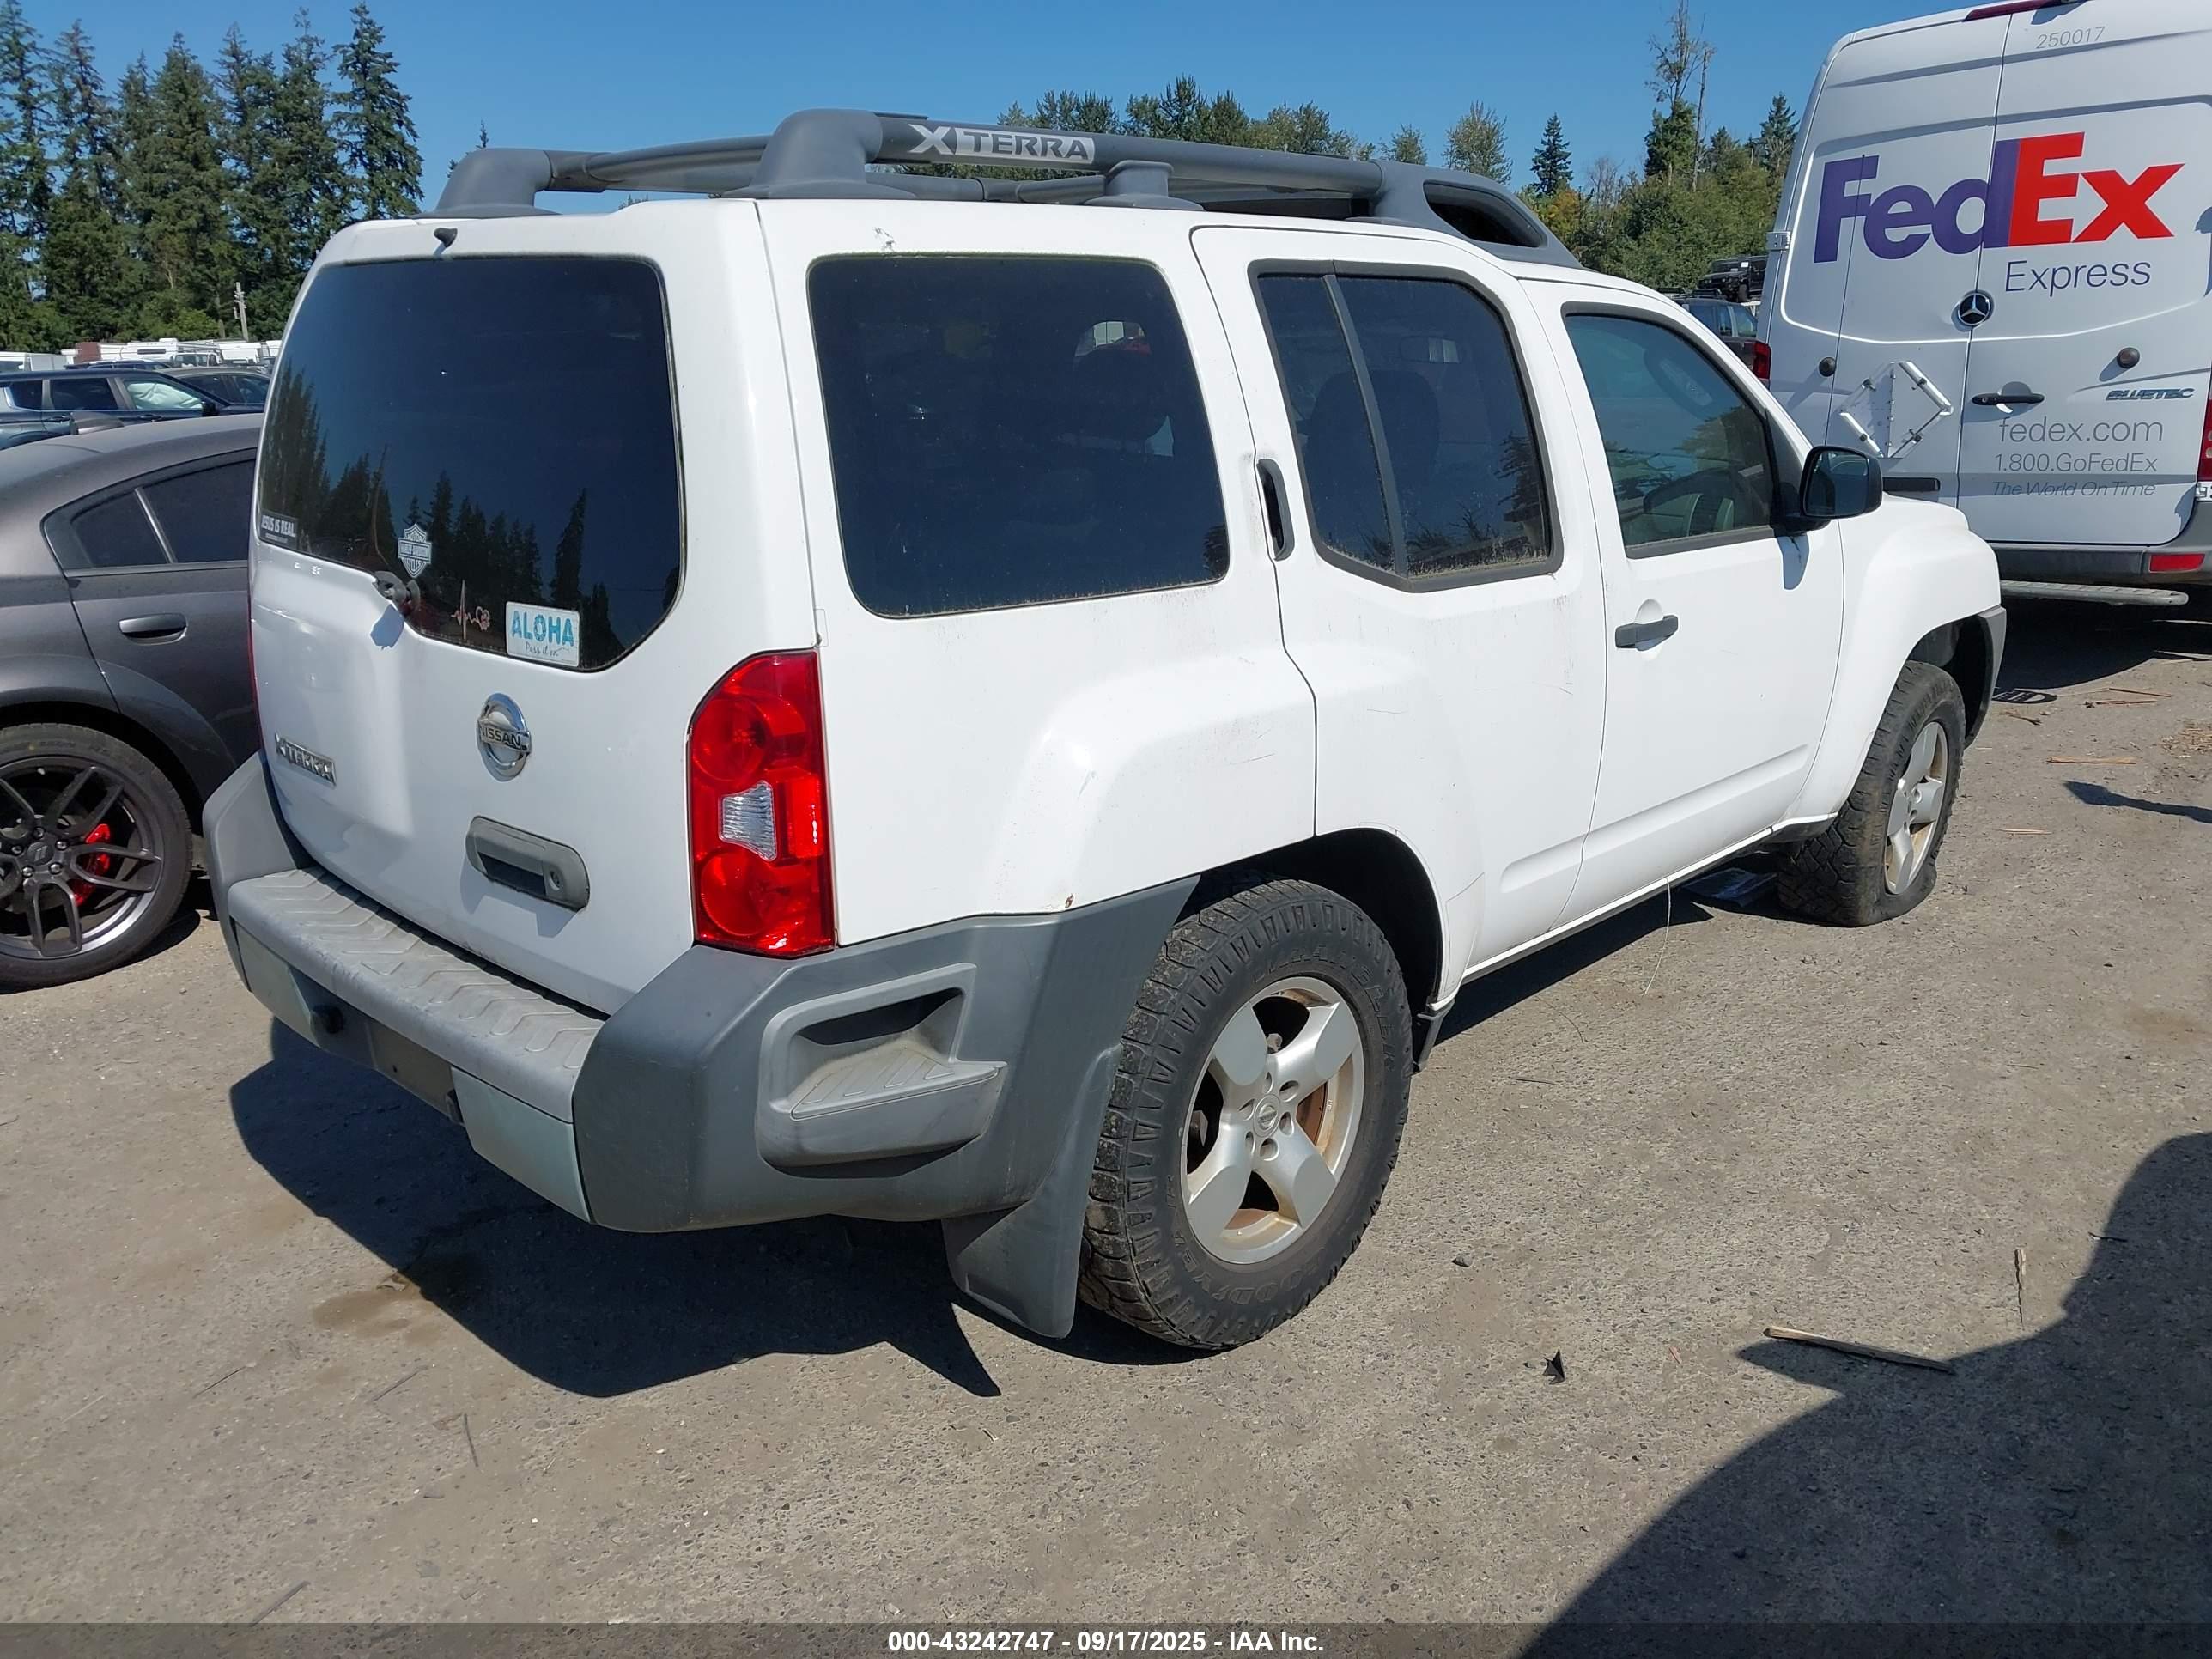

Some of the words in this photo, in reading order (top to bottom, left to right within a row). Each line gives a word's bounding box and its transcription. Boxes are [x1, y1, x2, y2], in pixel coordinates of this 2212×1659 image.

[2035, 26, 2106, 49] 250017
[908, 124, 1094, 161] XTERRA
[1813, 131, 2185, 263] FedEx
[2005, 259, 2151, 296] Express
[2106, 387, 2195, 401] BLUETEC
[1999, 416, 2163, 442] fedex.com
[1994, 453, 2158, 472] 1.800.GoFedEx
[1993, 481, 2022, 495] The
[2027, 481, 2077, 496] World
[2081, 481, 2107, 496] On
[2112, 481, 2155, 496] Time
[512, 611, 574, 647] ALOHA
[482, 726, 521, 746] NISSAN
